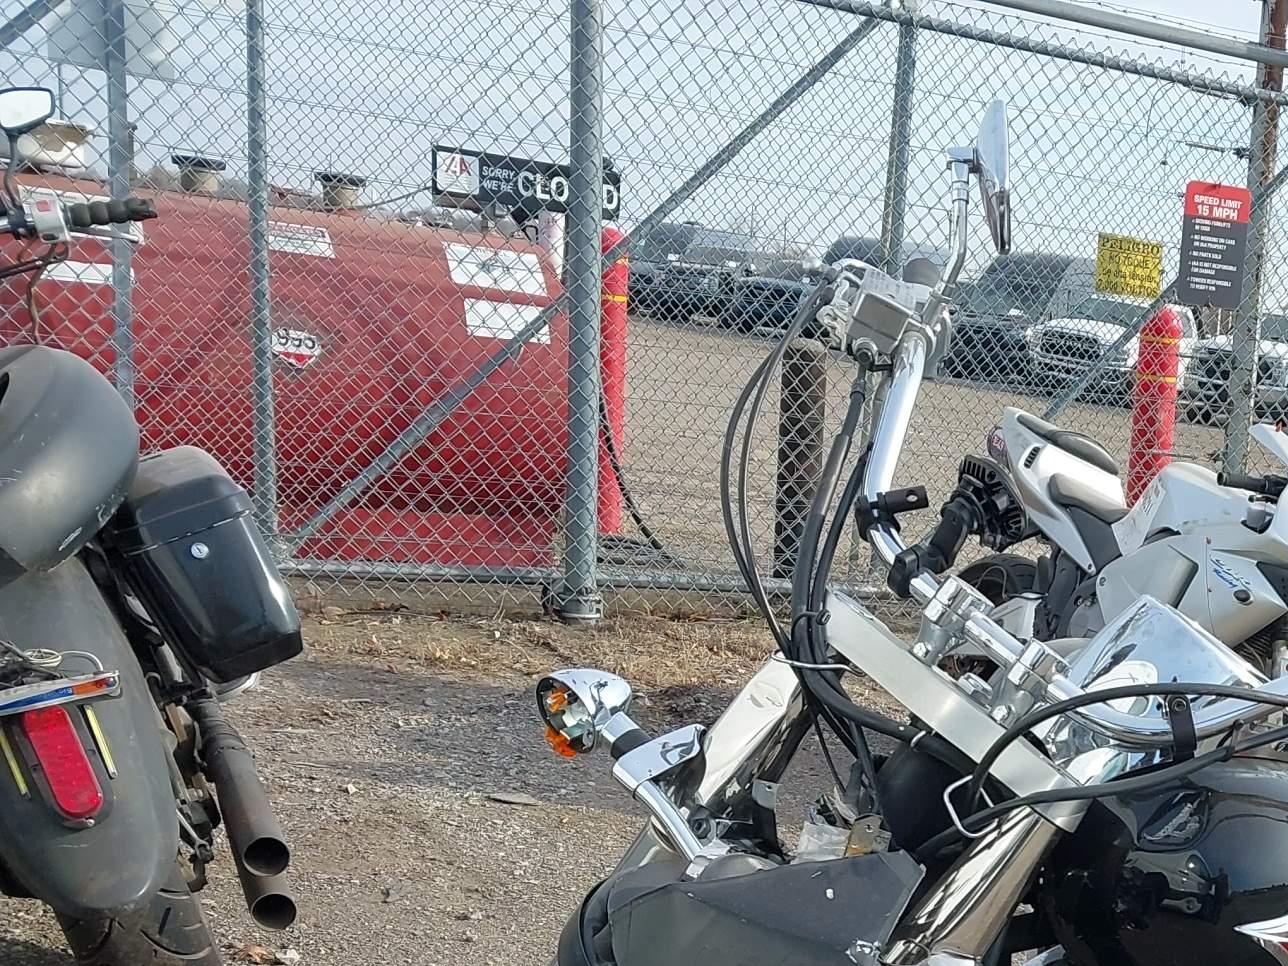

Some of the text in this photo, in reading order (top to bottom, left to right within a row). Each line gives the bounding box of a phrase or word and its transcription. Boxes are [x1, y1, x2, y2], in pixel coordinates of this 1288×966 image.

[482, 165, 515, 180] SORRY
[483, 179, 514, 194] WE'RE
[517, 170, 618, 210] CLOD
[1193, 194, 1243, 209] SPEED LIMIT
[1197, 204, 1238, 220] 15 MPH
[1102, 237, 1160, 256] PELIGRO
